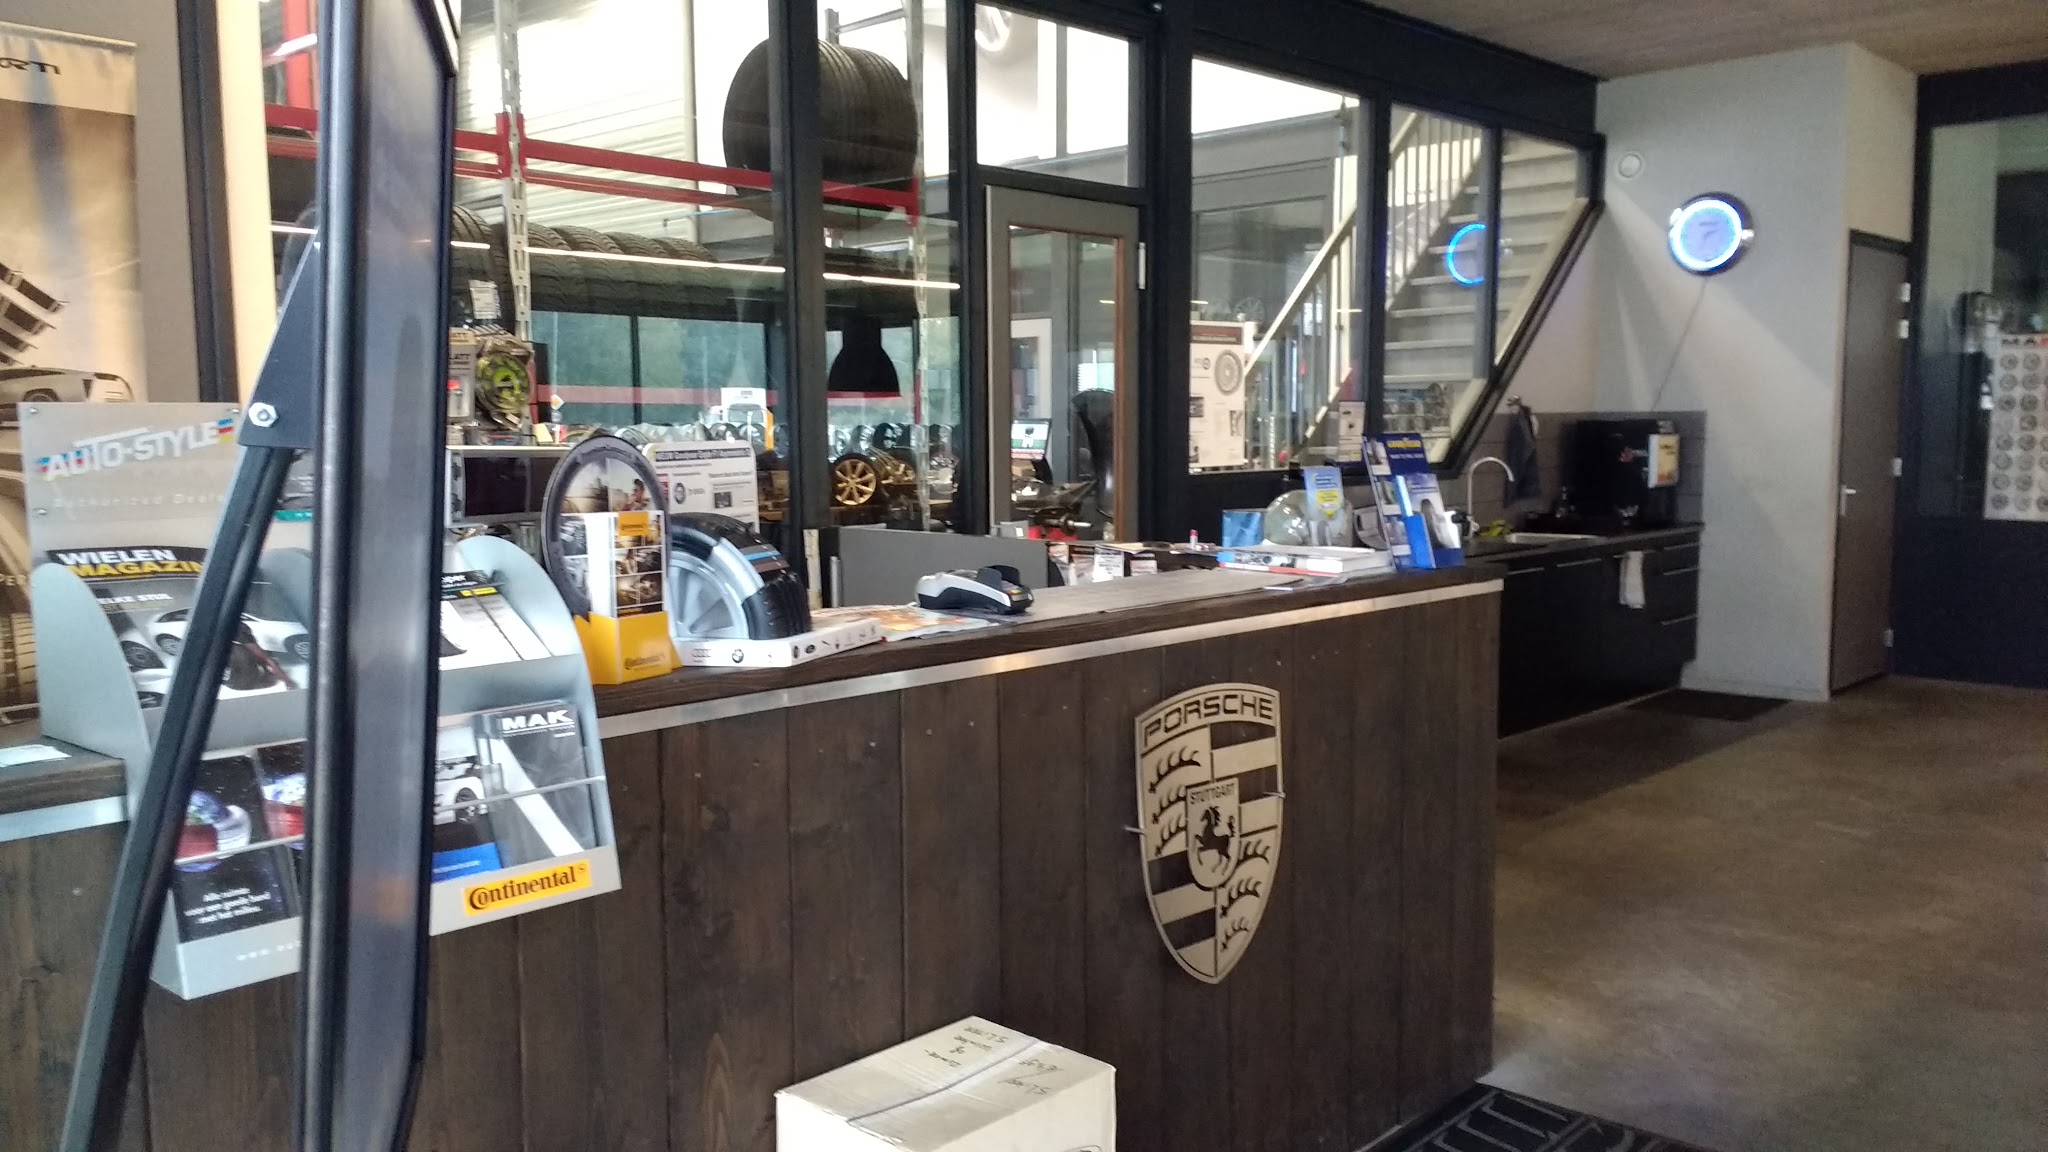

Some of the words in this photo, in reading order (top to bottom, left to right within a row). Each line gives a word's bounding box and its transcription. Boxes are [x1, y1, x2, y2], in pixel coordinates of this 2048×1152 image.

[46, 421, 219, 482] AUTO-STYLE
[56, 549, 178, 565] WIELEN
[501, 710, 574, 731] MAK
[1144, 694, 1273, 747] PORSCHE
[469, 866, 577, 910] Continental
